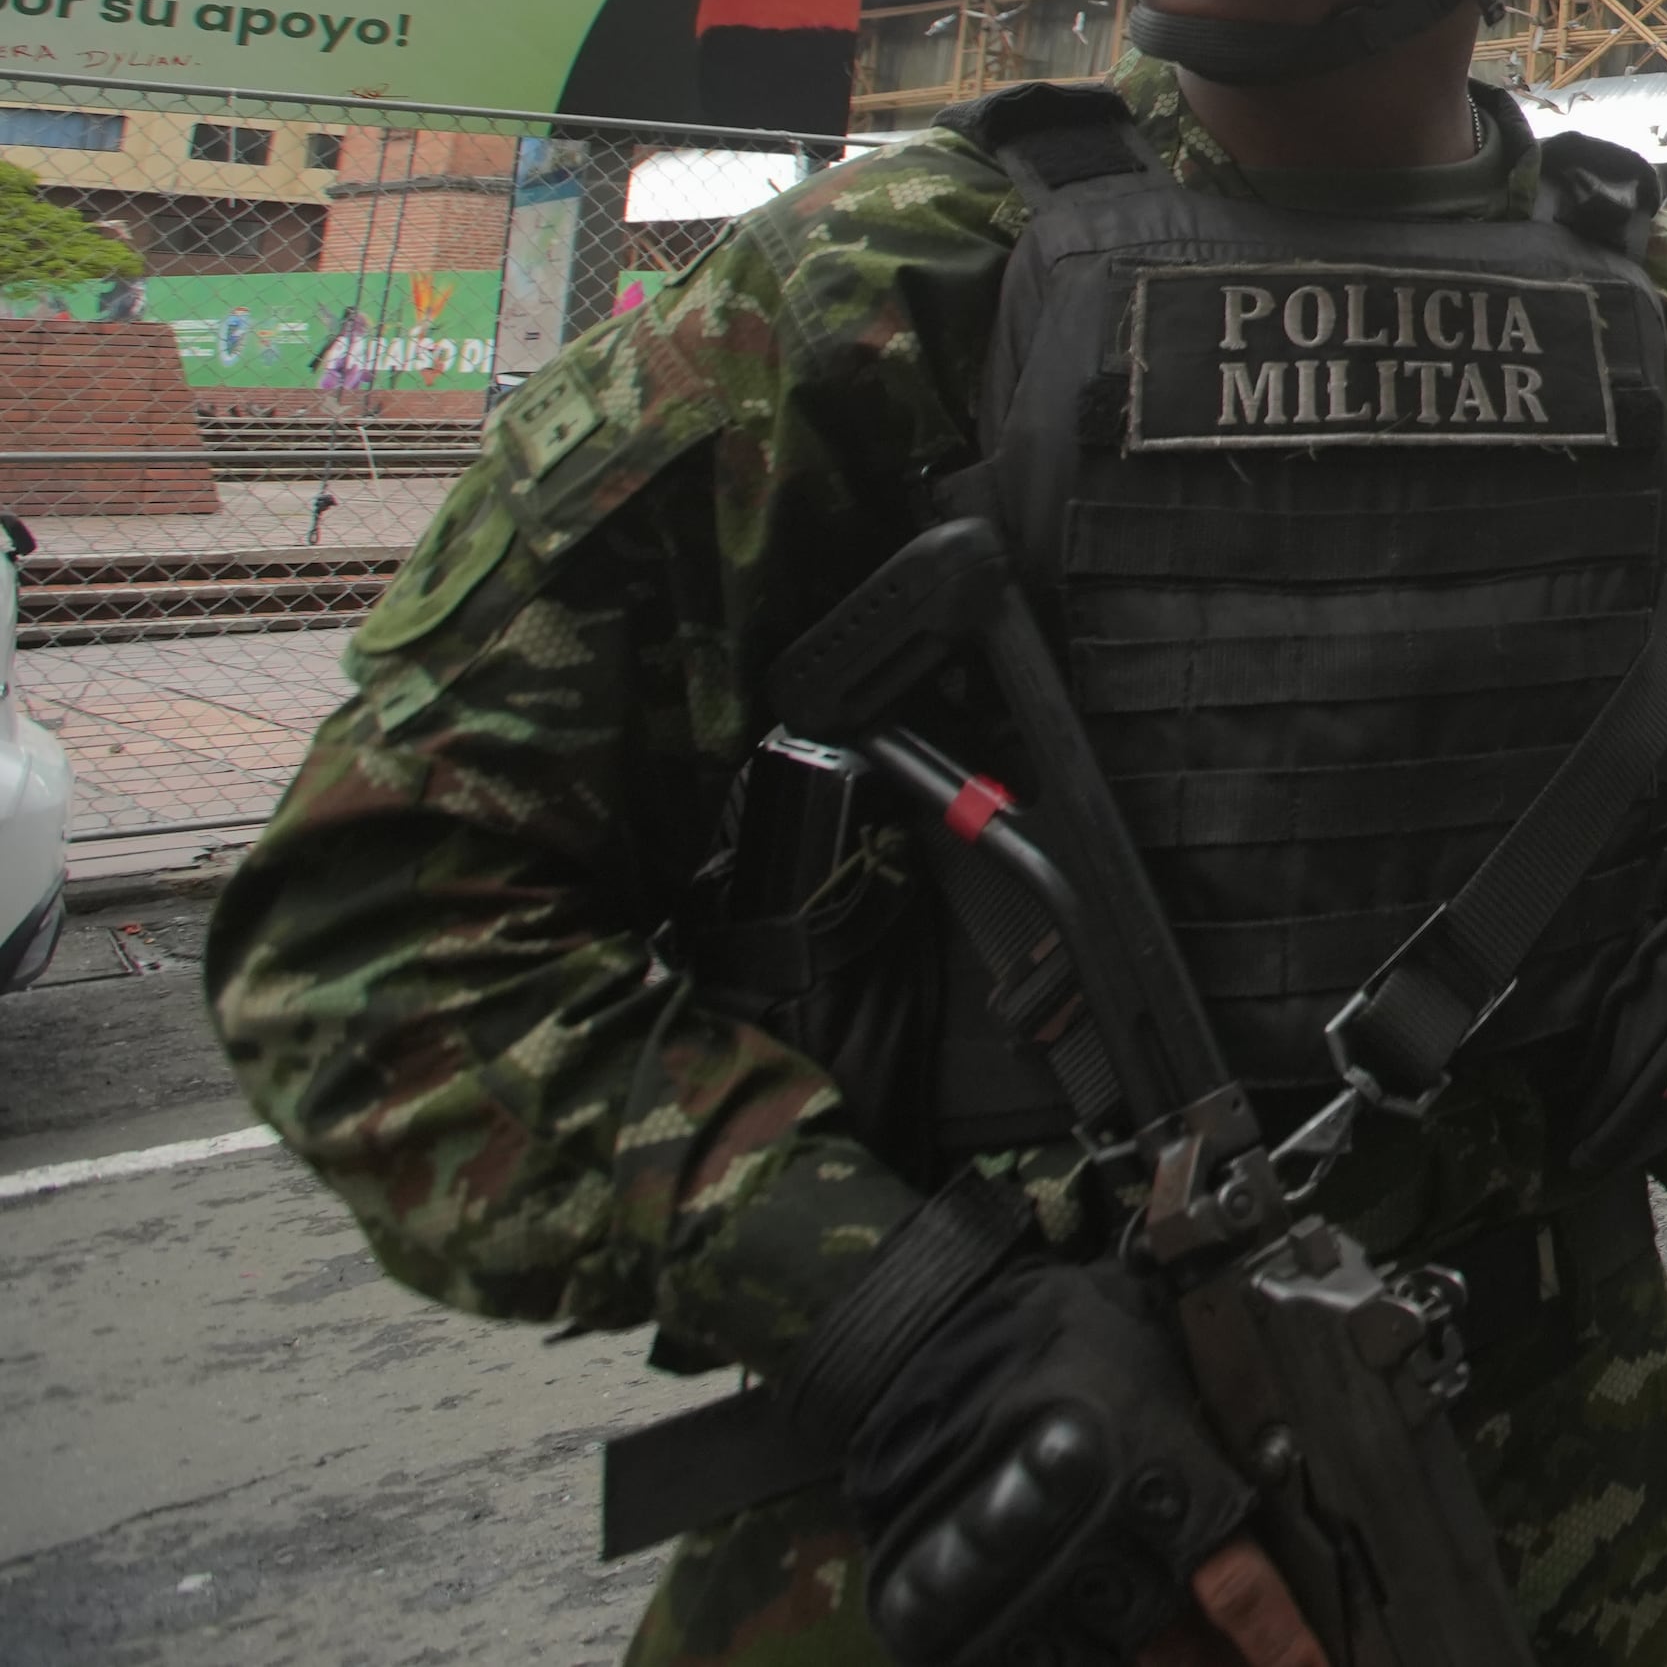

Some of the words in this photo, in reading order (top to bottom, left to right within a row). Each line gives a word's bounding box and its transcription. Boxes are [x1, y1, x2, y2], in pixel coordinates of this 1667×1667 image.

[193, 0, 414, 54] apoyo!
[1218, 284, 1545, 356] POLICIA
[1214, 359, 1550, 427] MILITAR
